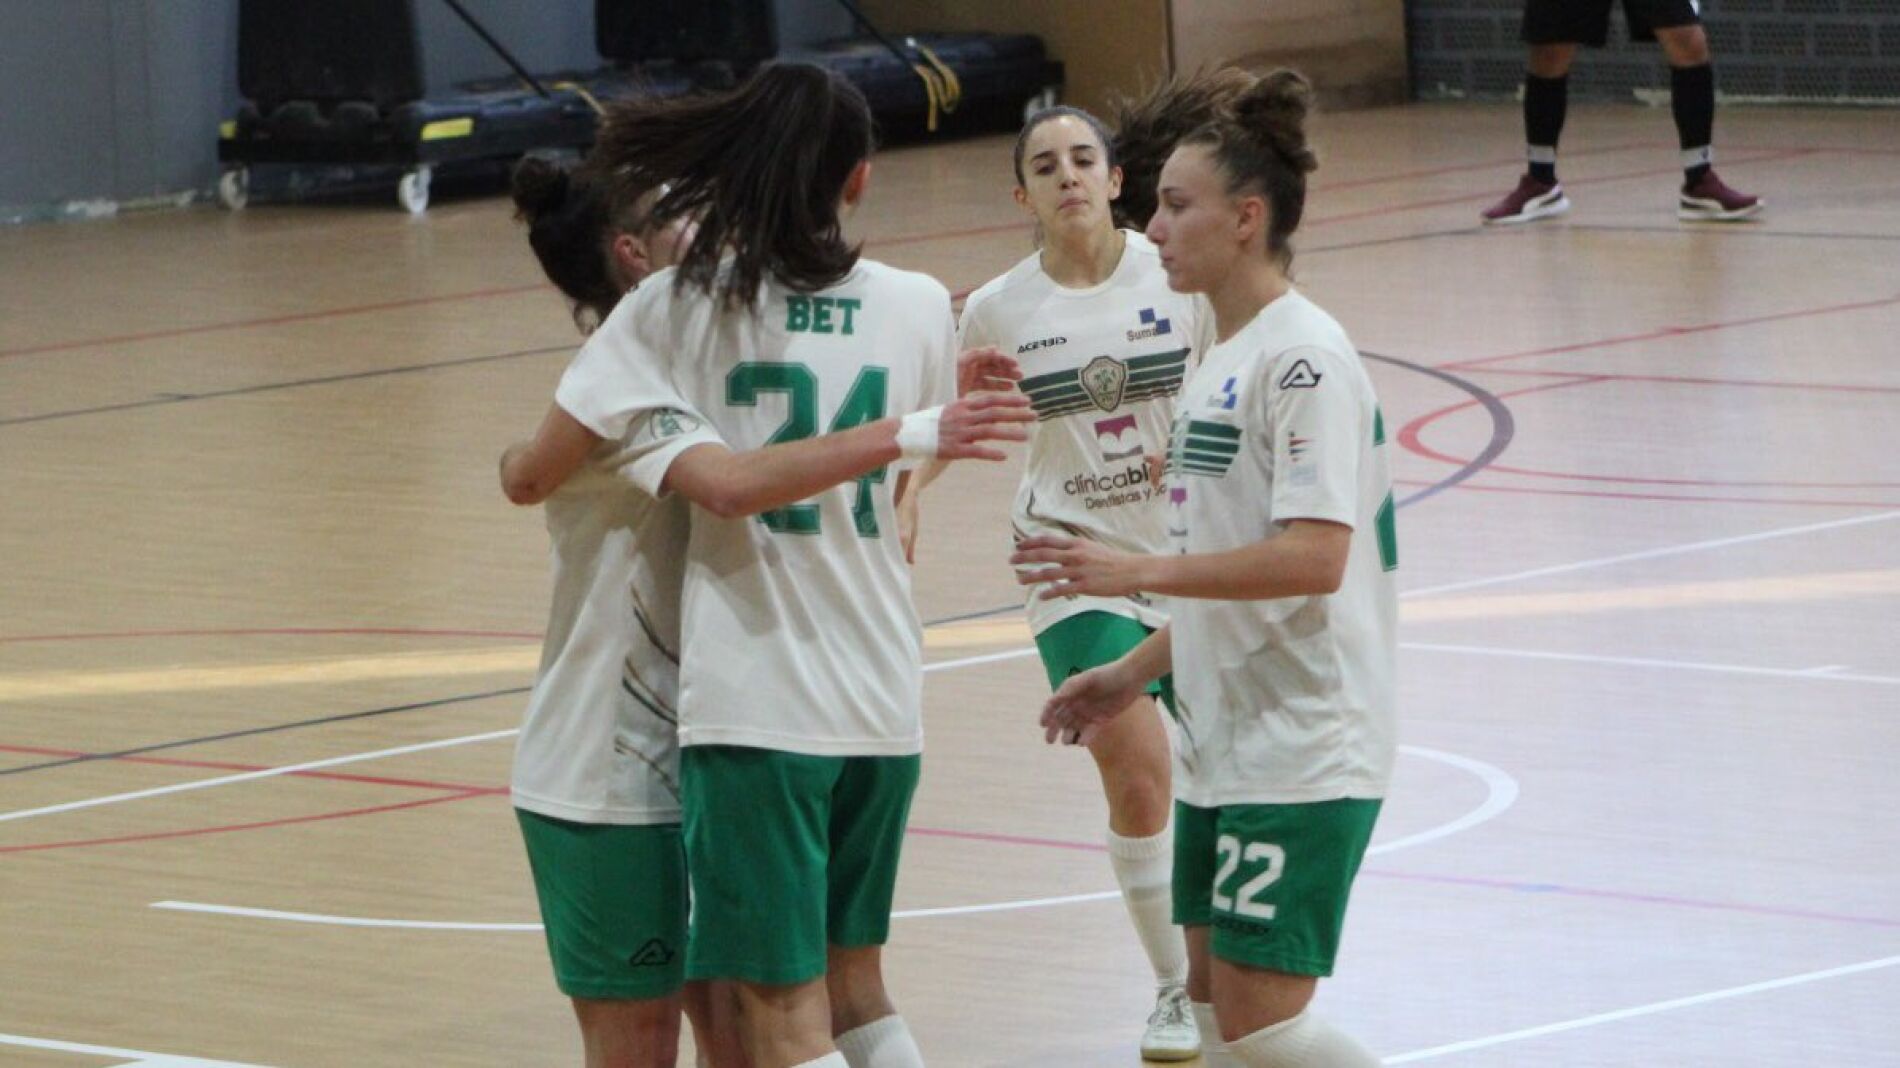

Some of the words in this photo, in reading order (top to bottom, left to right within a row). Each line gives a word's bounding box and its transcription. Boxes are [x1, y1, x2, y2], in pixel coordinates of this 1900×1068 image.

[786, 295, 861, 335] BET
[726, 362, 889, 538] 24
[1064, 463, 1160, 495] clínicabl
[1212, 835, 1286, 920] 22
